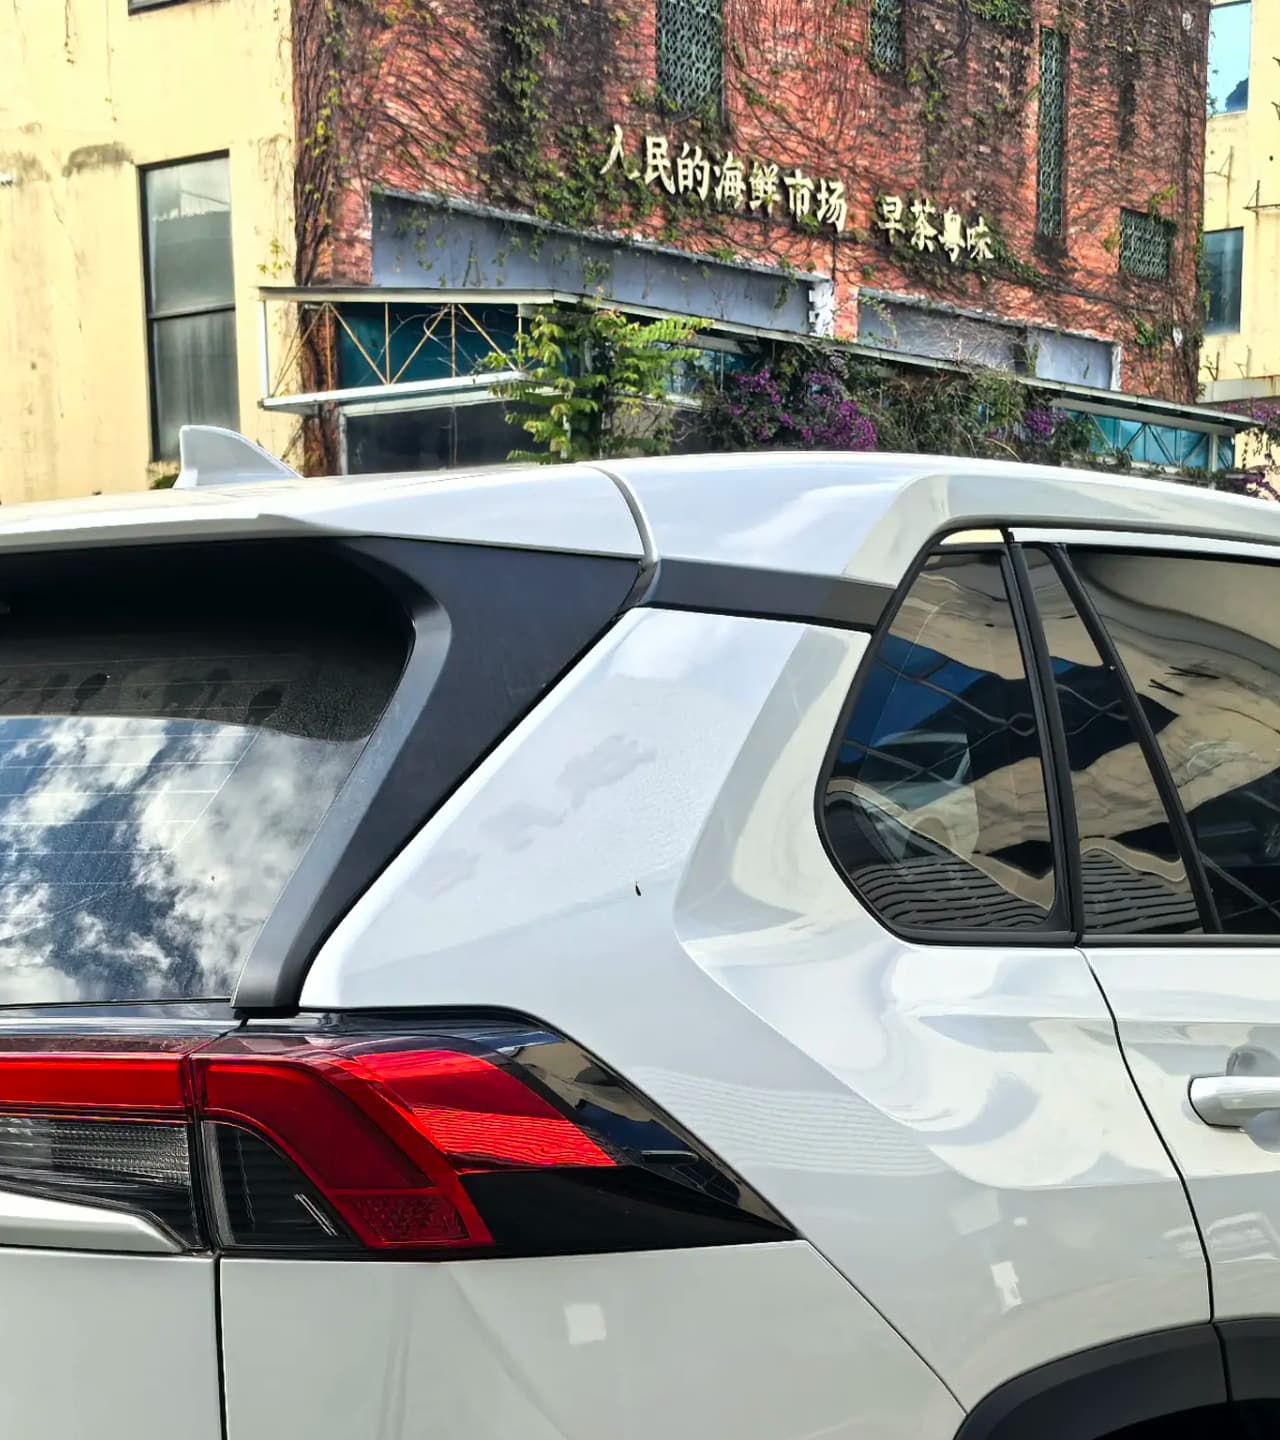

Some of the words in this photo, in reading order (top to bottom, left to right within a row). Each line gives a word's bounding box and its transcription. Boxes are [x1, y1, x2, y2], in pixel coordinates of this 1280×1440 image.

[600, 124, 848, 233] 人民的海鲜市场
[878, 195, 994, 262] 早茶粤味
